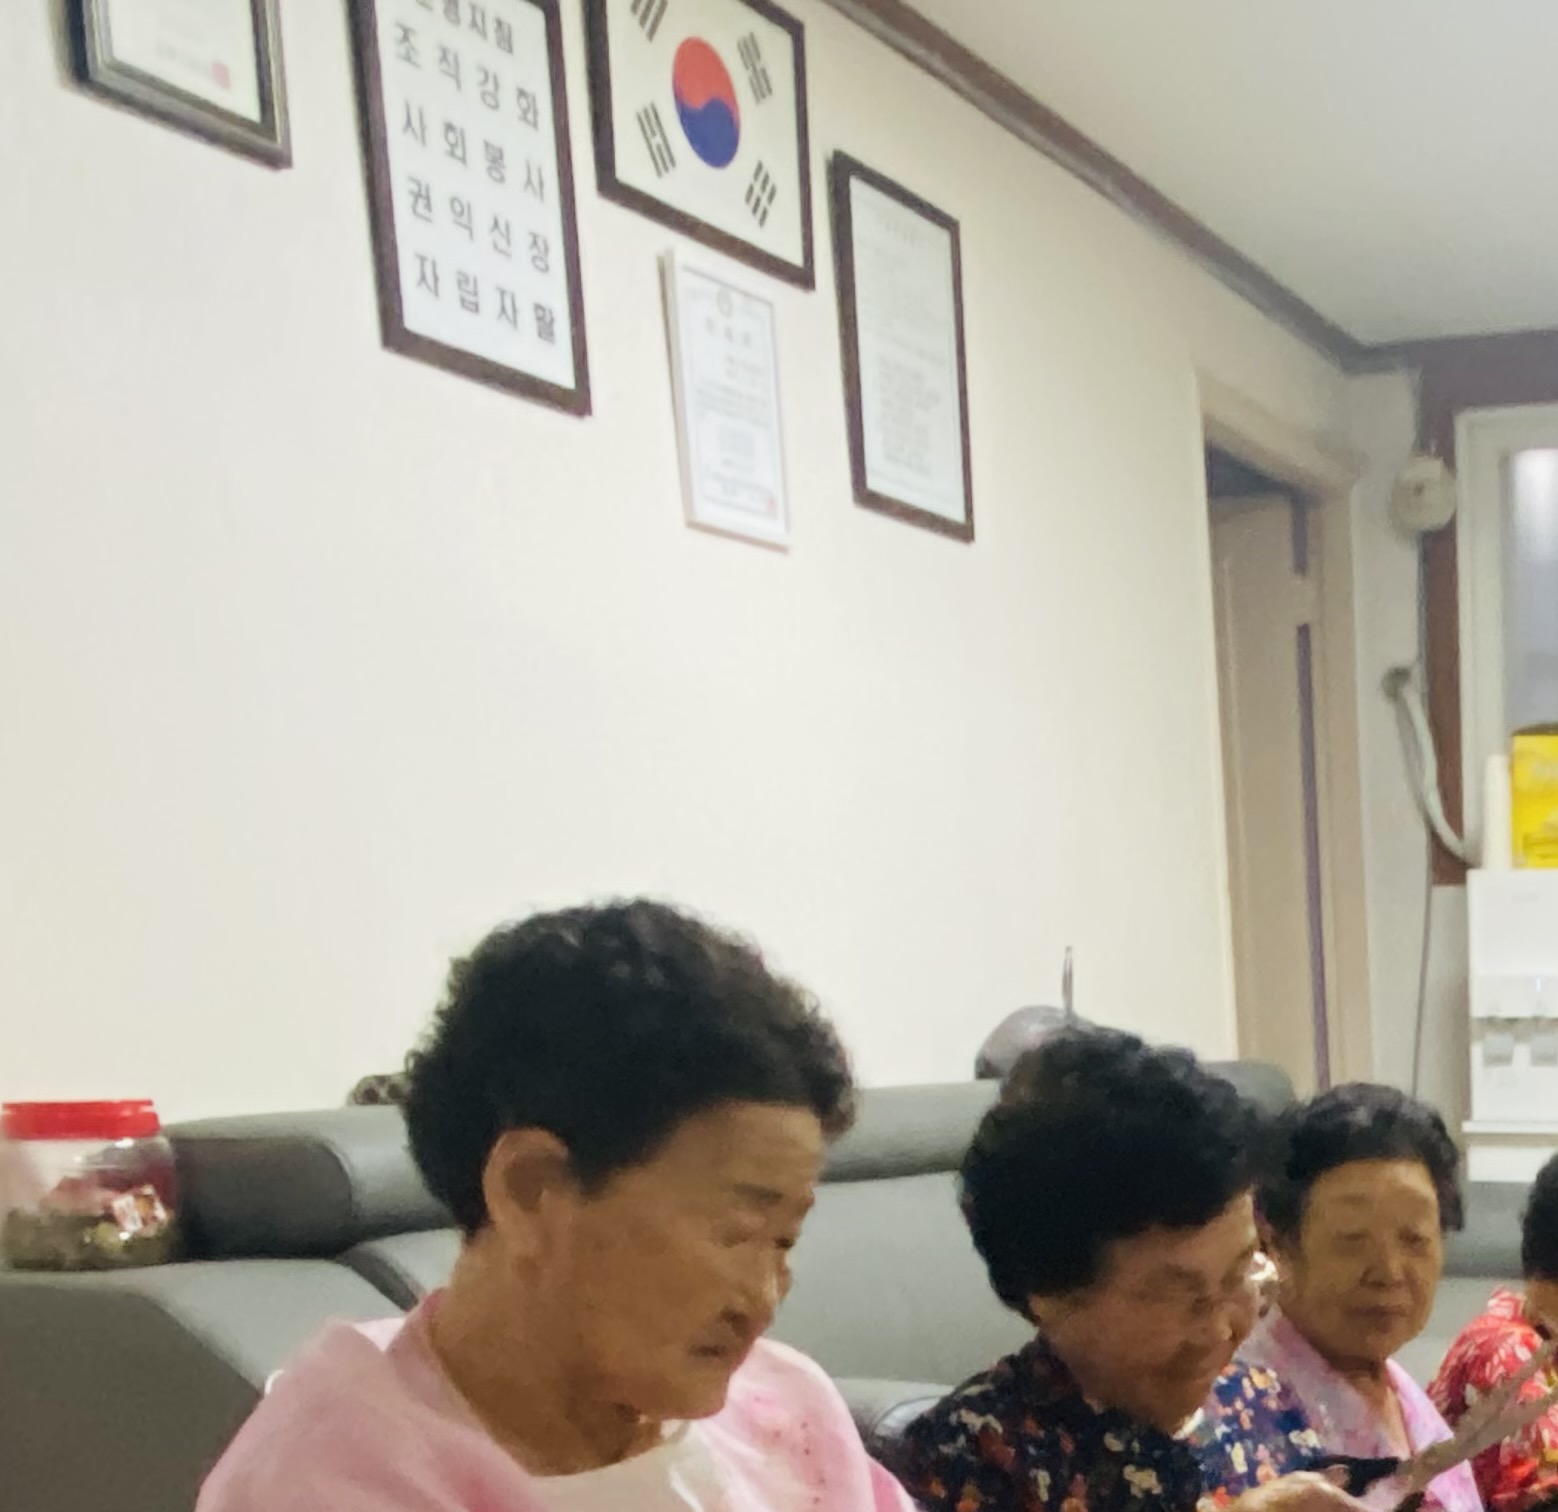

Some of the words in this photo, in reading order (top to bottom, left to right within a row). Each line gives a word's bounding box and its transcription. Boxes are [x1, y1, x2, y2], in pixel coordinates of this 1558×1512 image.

[395, 20, 539, 131] 조직강화
[403, 98, 545, 204] 사회봉사
[407, 176, 551, 274] 권익신장
[415, 253, 556, 345] 자립자활
